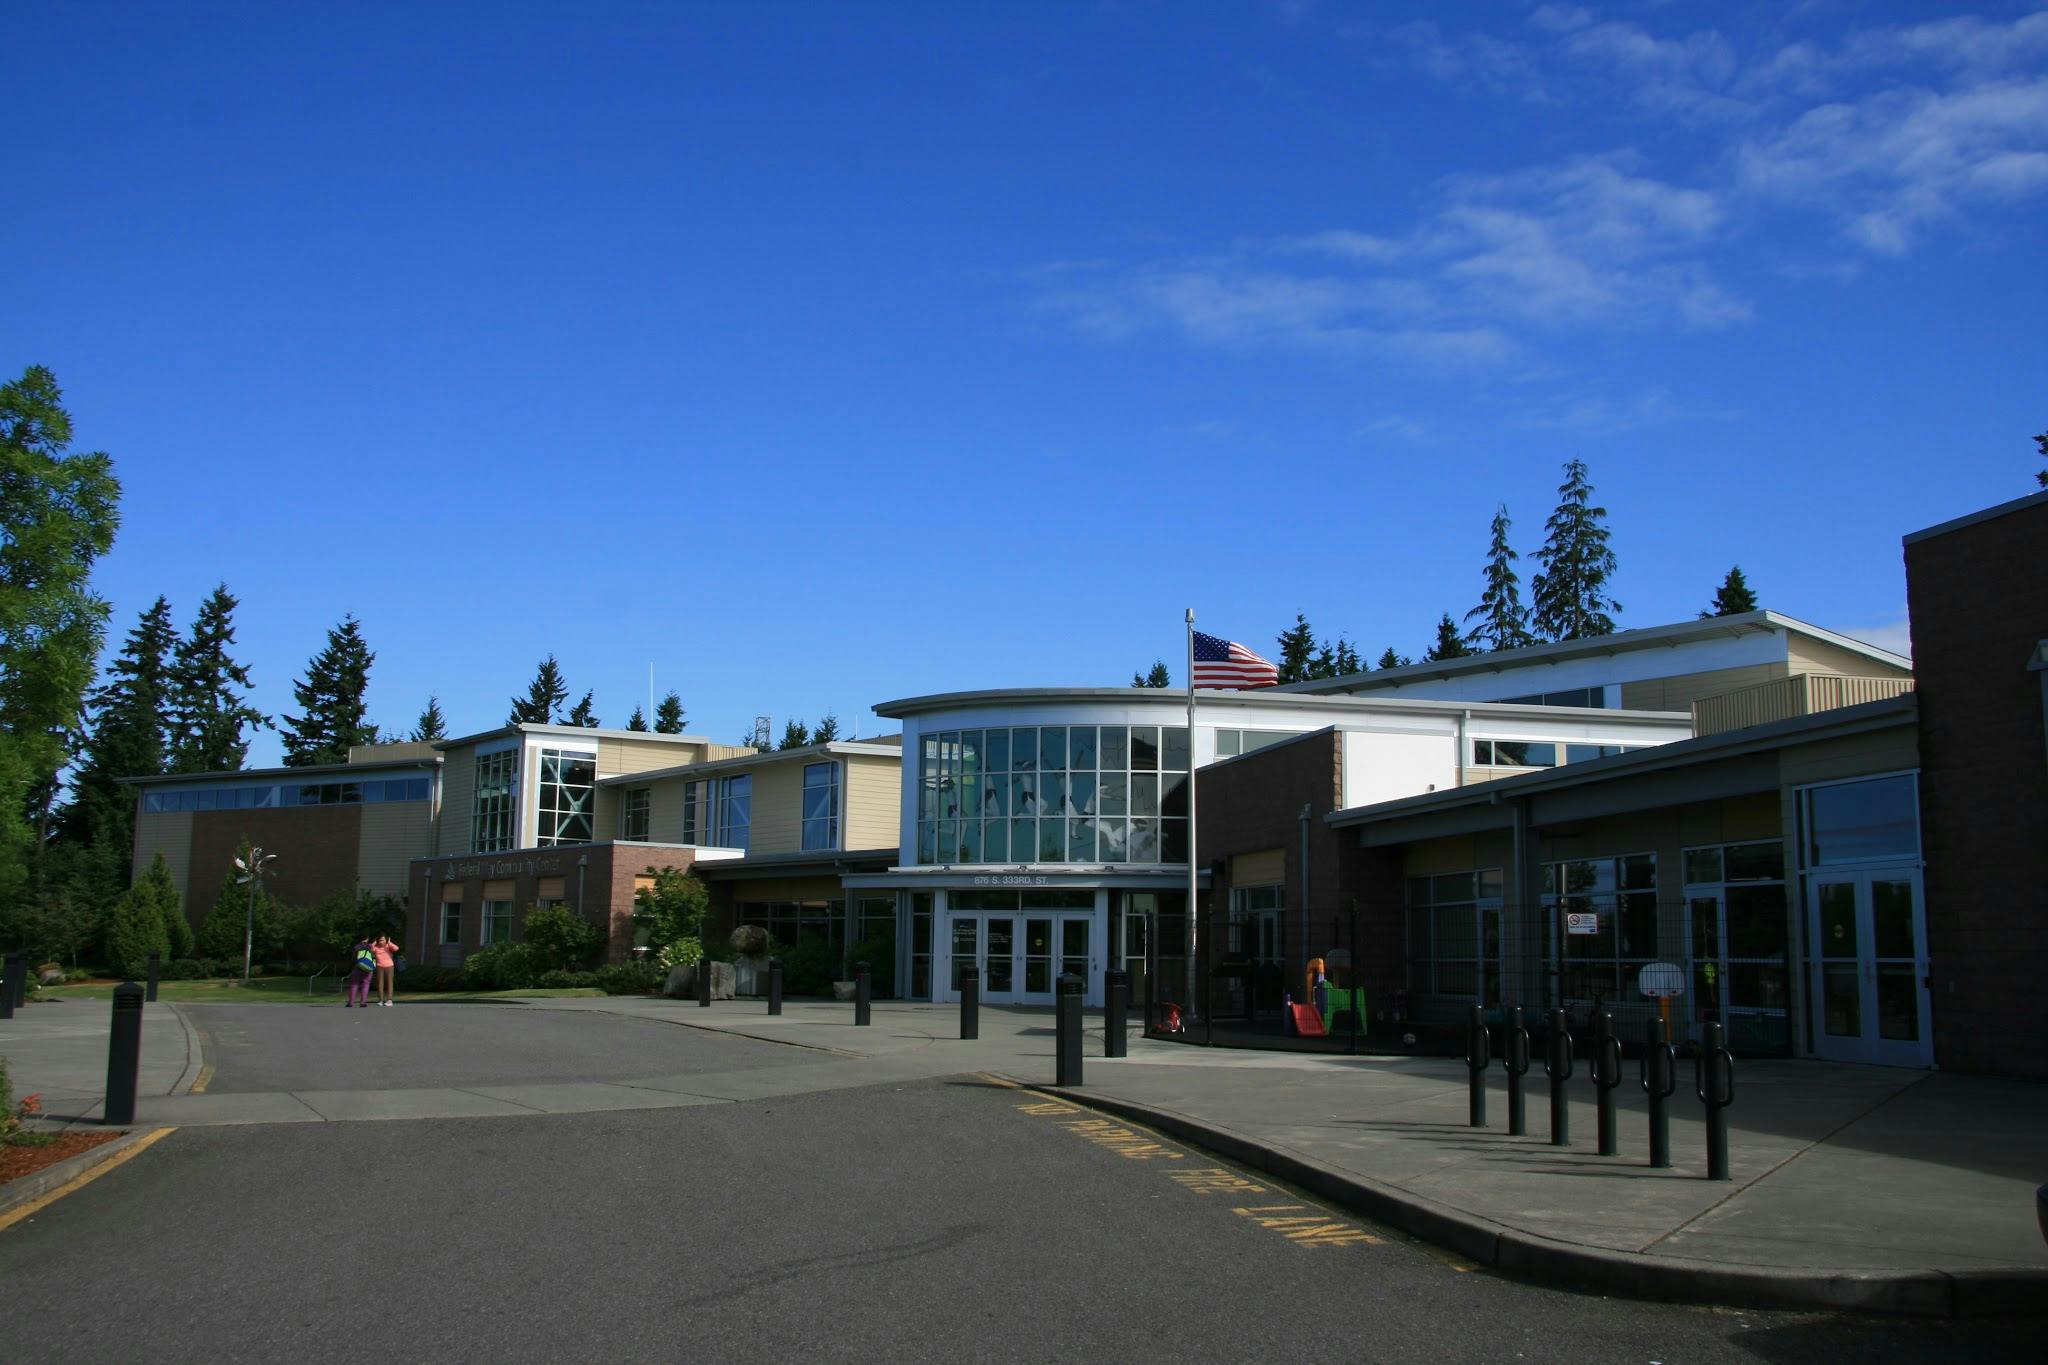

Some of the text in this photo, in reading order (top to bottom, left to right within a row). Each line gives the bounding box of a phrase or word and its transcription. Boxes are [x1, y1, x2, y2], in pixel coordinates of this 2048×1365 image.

[974, 876, 989, 885] 876
[1012, 1103, 1390, 1248] NO PARKING FIRE LANE
